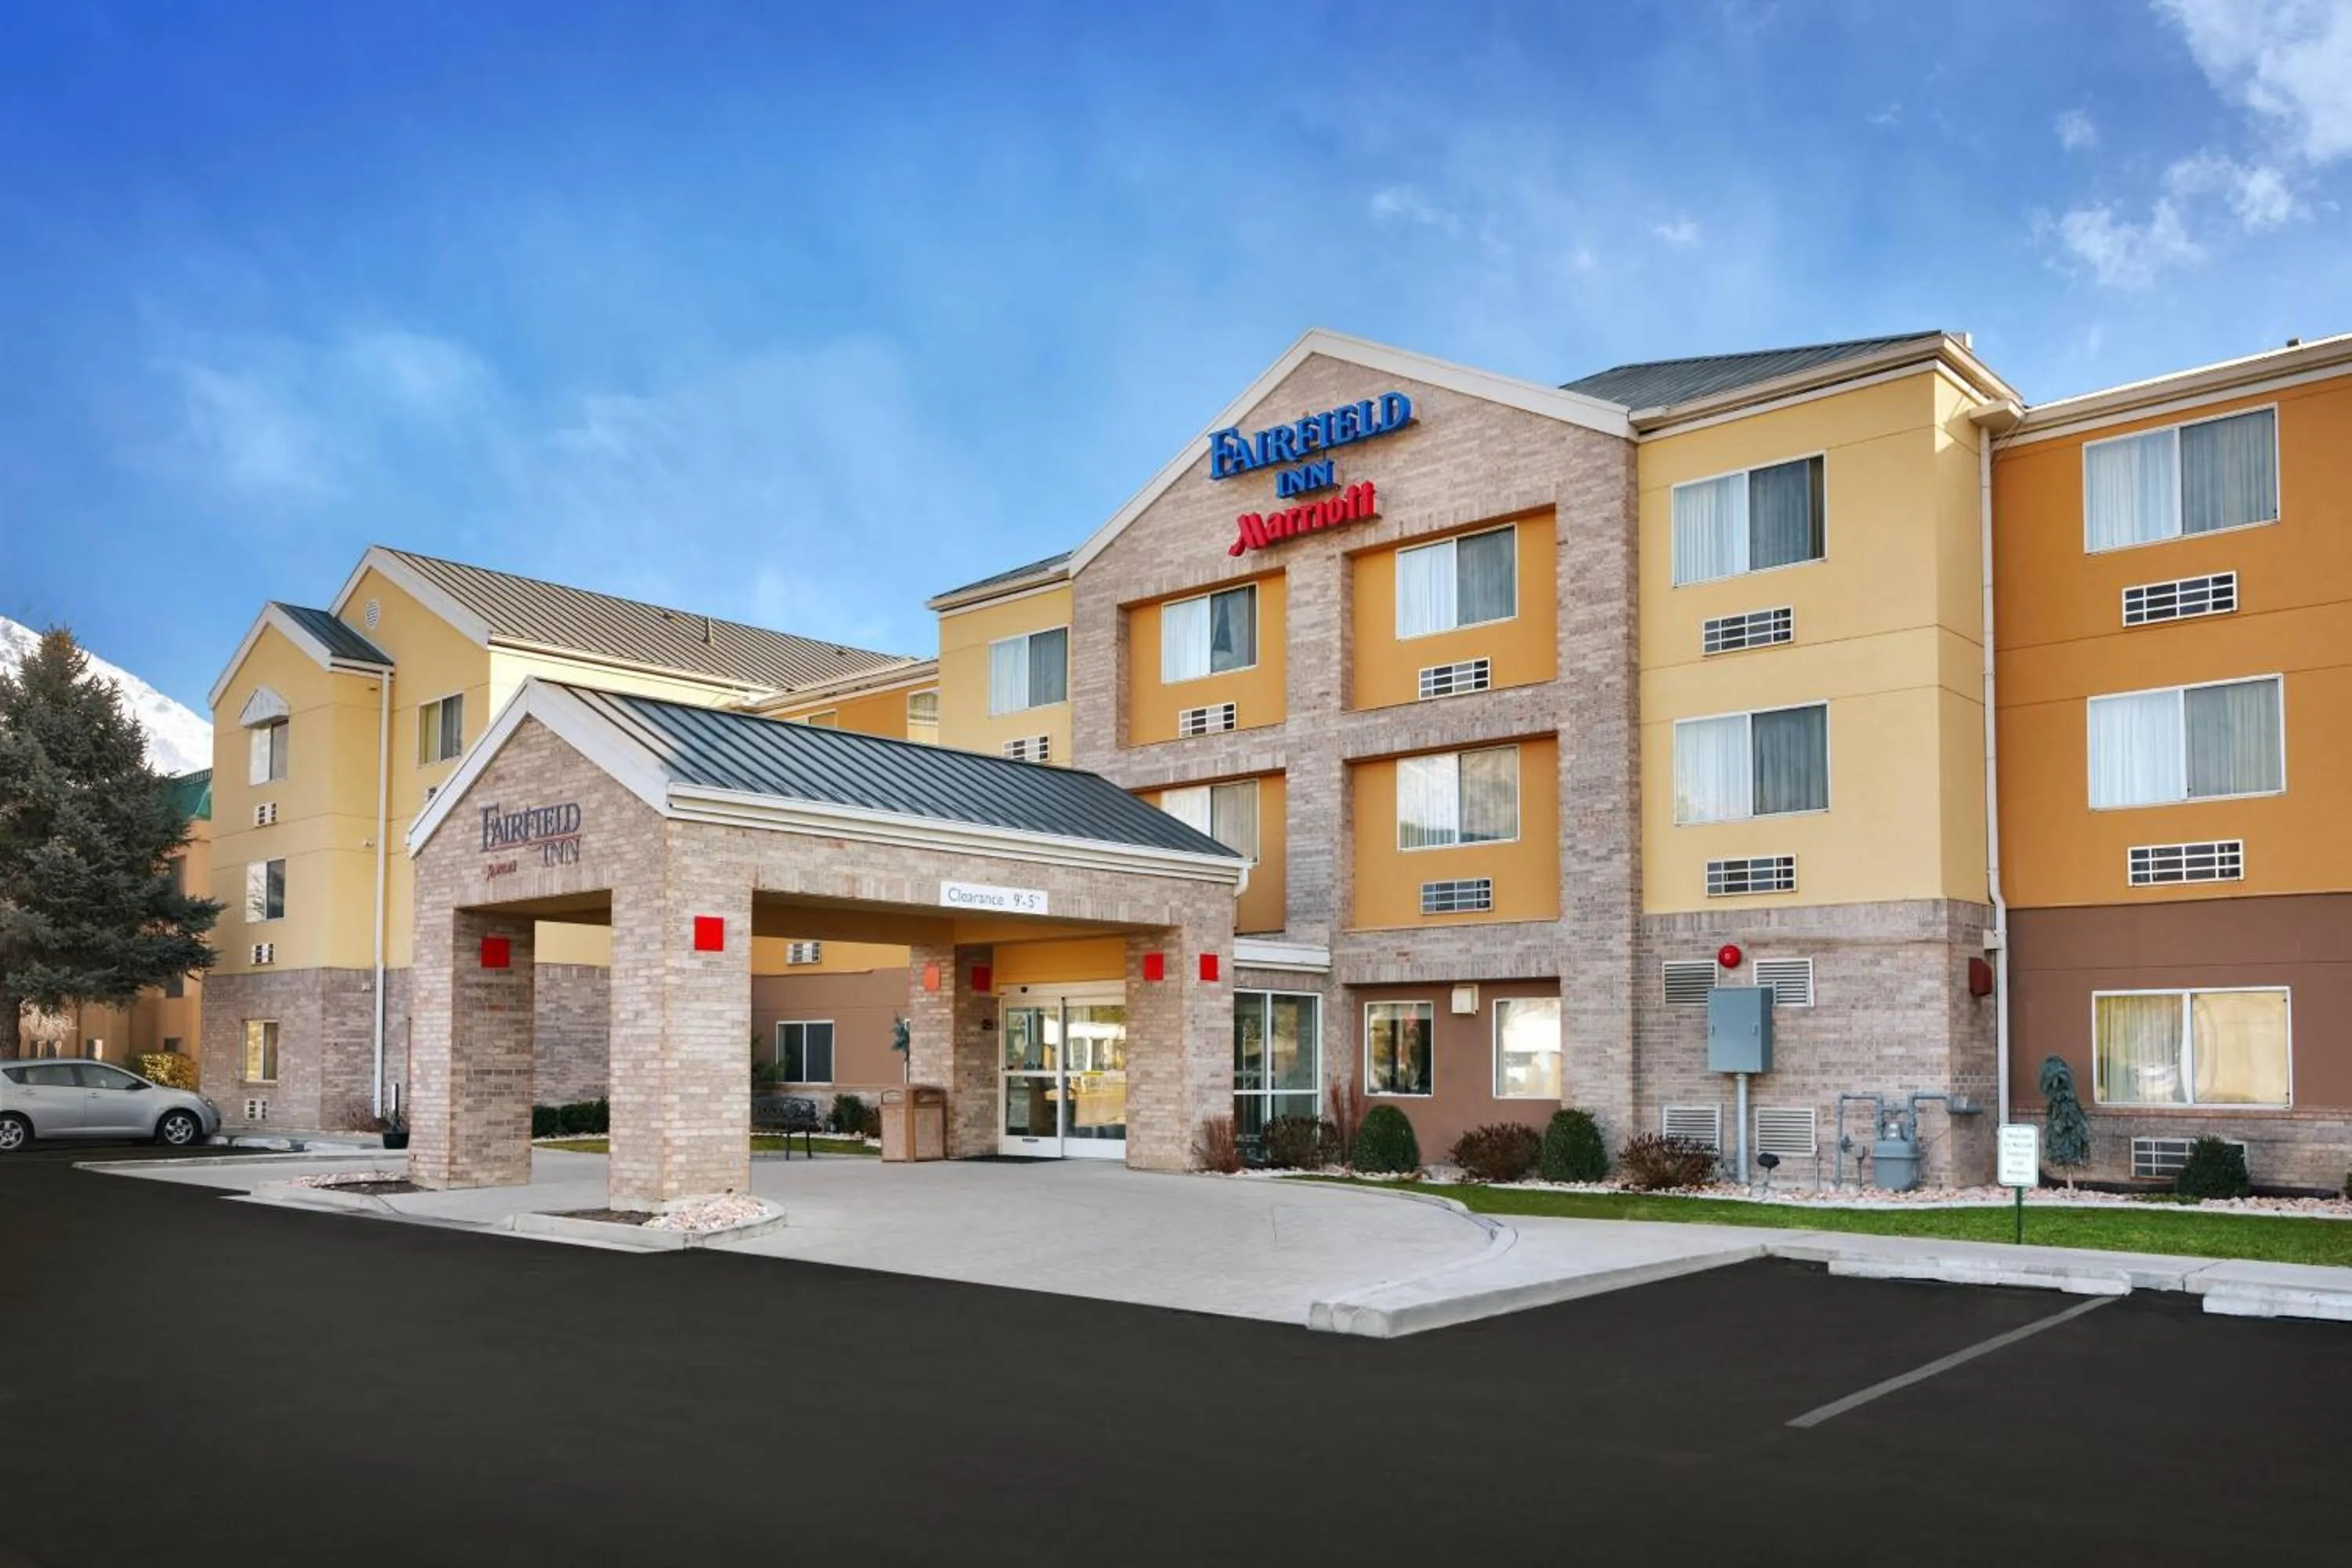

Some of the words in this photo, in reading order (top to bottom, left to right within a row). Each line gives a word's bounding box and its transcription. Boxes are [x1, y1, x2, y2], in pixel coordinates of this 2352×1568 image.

[1207, 391, 1414, 480] FAIRFIELD
[1276, 459, 1335, 498] INN
[1229, 481, 1374, 557] Marriott
[480, 802, 581, 852] FAIRFIELD
[541, 838, 581, 867] INN
[948, 887, 1004, 906] Clearance
